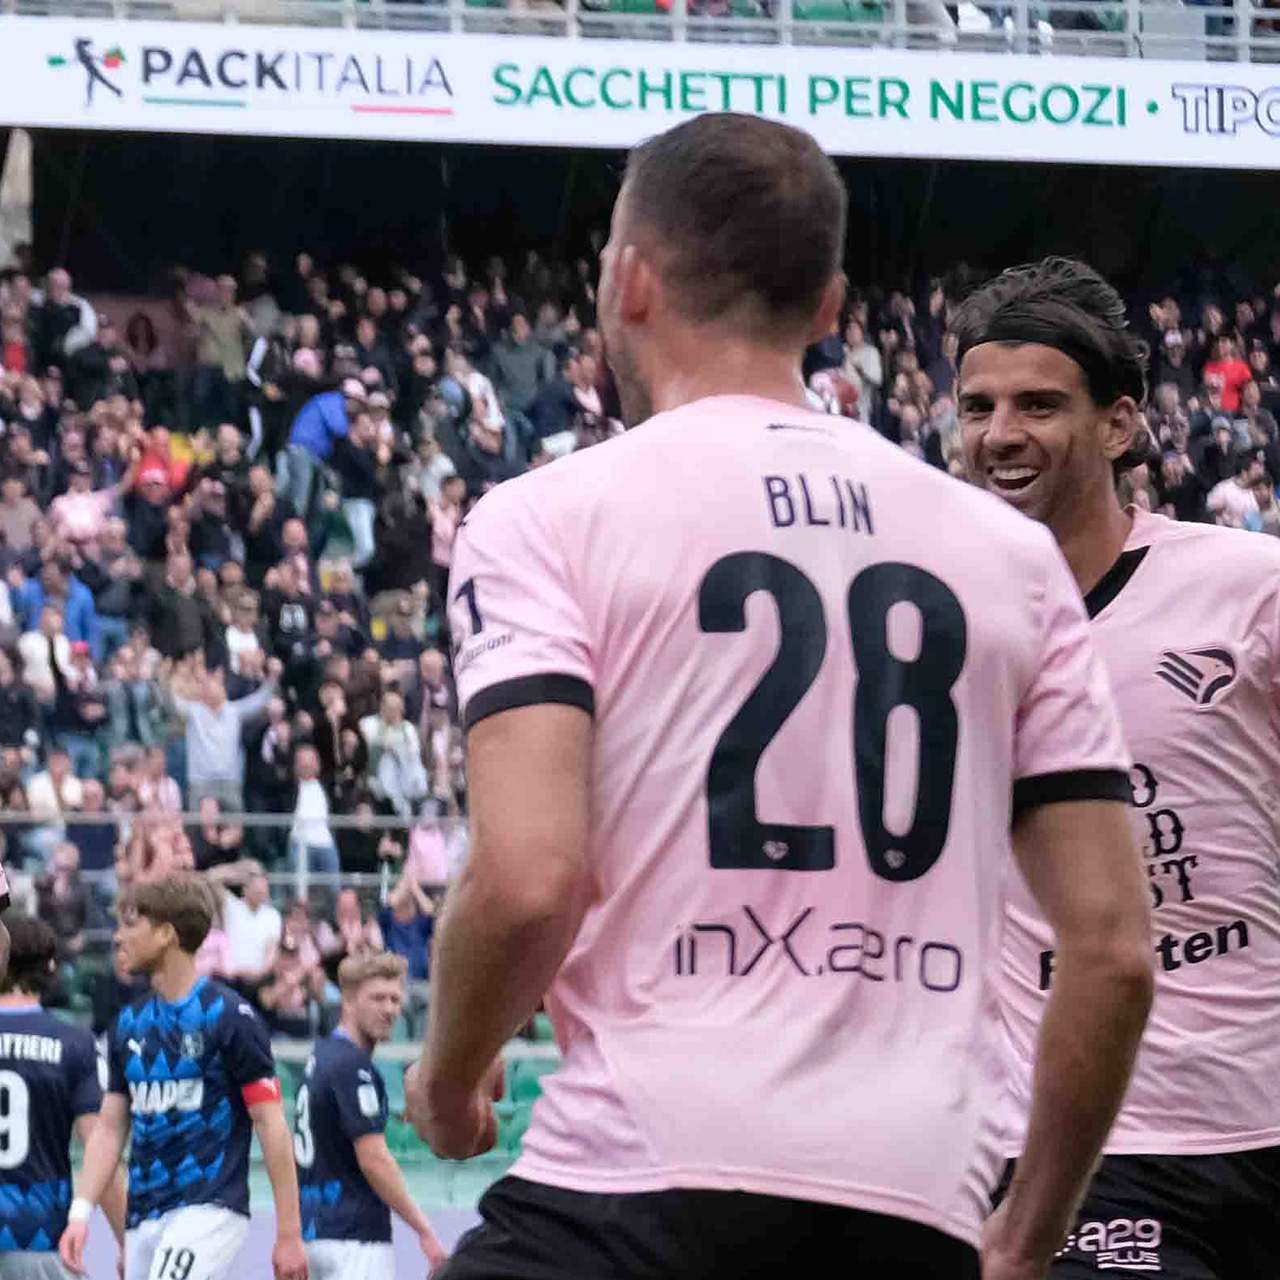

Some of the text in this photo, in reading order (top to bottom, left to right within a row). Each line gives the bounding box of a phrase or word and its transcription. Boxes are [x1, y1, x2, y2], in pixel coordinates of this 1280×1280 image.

[492, 63, 1126, 127] SACCHETTI PER NEGOZI
[763, 474, 875, 535] BLIN
[698, 550, 967, 882] 28
